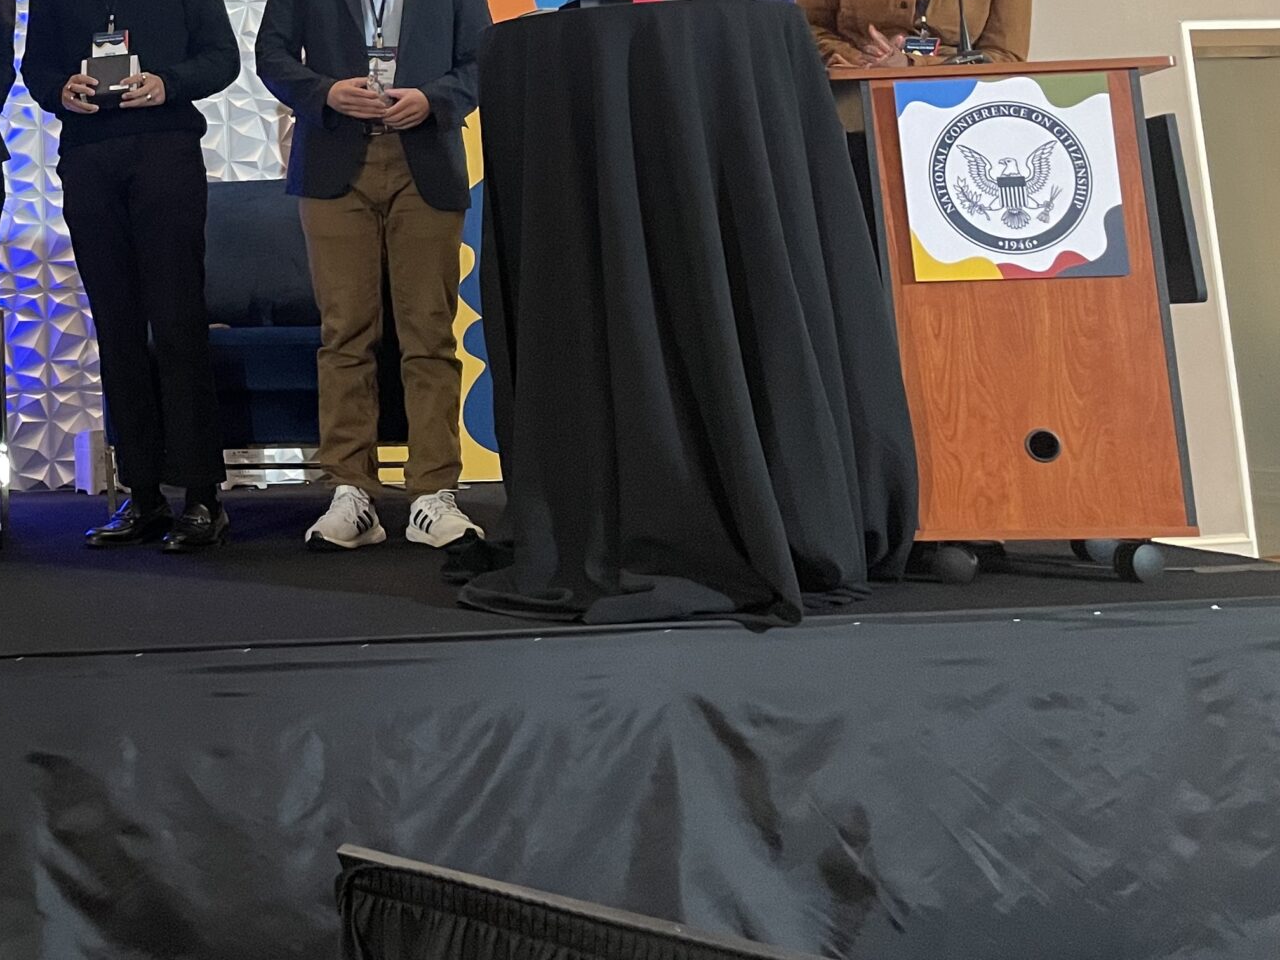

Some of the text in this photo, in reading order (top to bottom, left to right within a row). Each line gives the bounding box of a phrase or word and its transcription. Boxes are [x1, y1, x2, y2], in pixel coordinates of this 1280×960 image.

[933, 105, 1089, 214] NATIONAL CONFERENCE ON CITIZENSHIP
